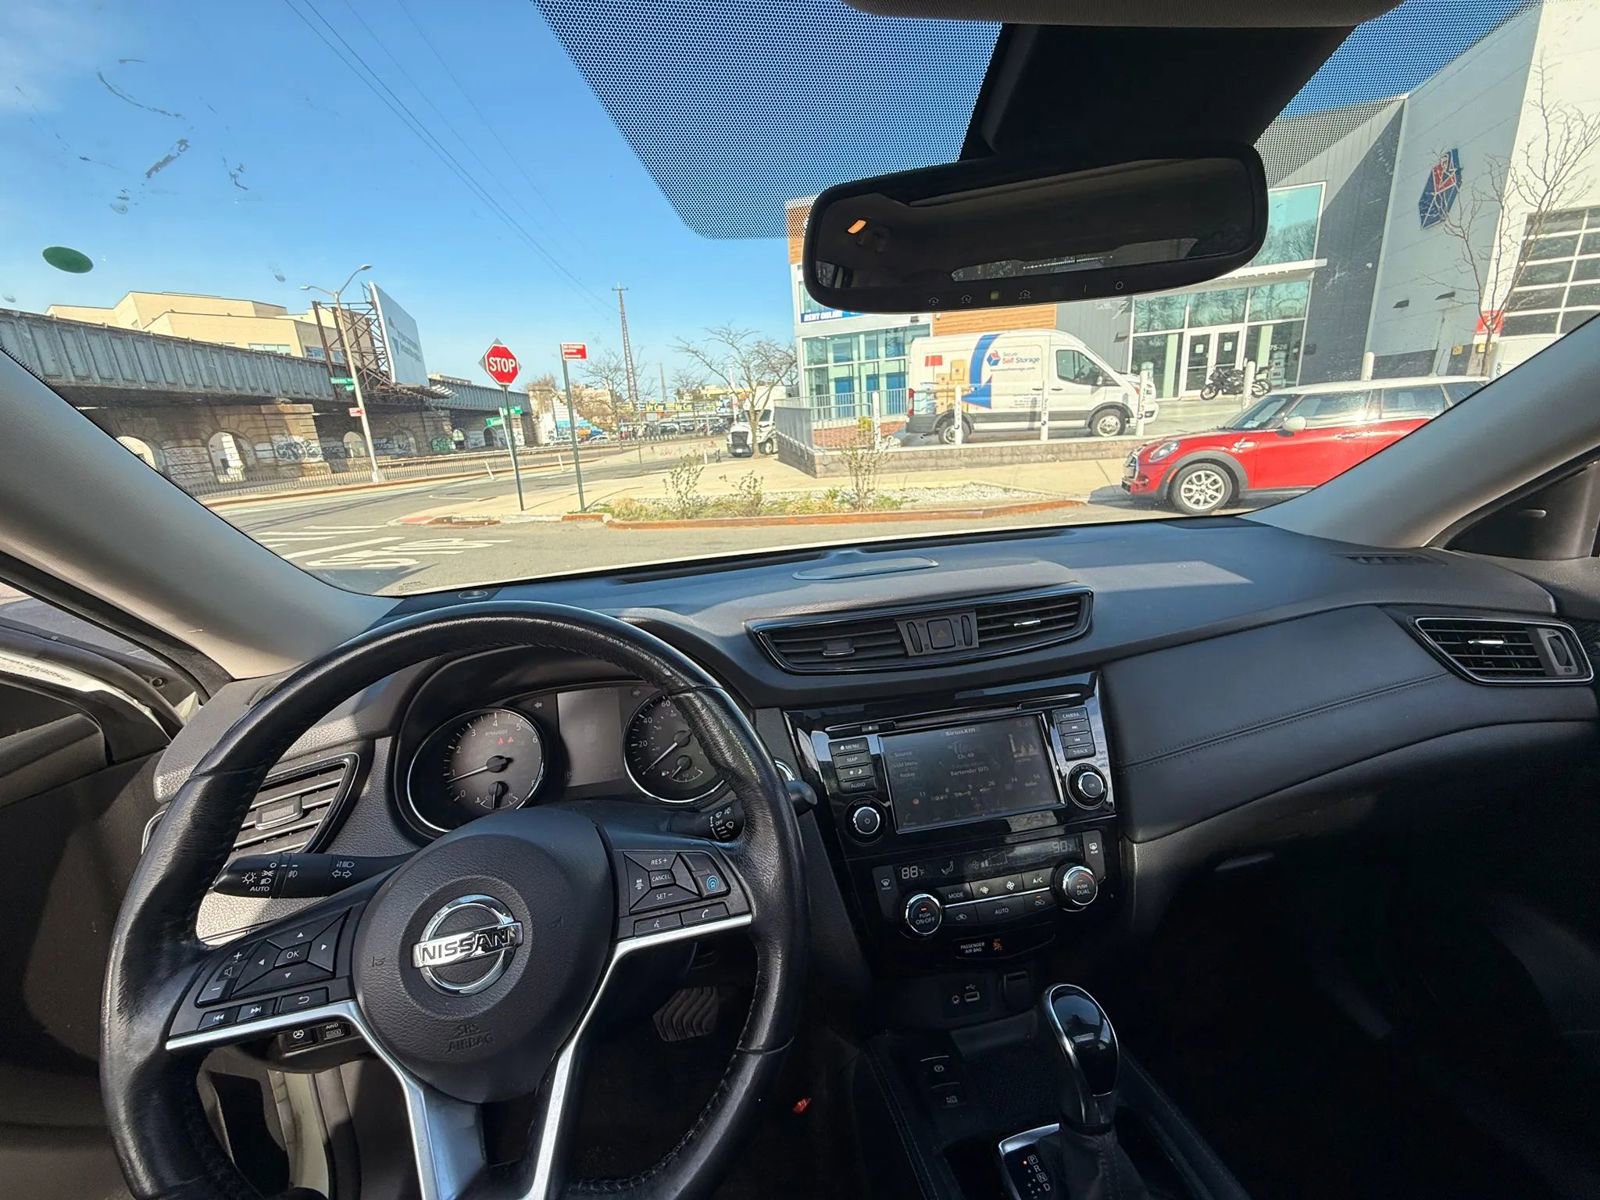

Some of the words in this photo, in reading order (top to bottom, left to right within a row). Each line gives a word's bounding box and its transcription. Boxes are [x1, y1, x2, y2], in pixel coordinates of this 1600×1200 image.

[488, 356, 516, 374] STOP
[1015, 356, 1041, 365] Storage
[492, 719, 498, 727] 4
[643, 716, 653, 724] 40
[515, 722, 522, 731] 5
[471, 728, 477, 737] 3
[532, 735, 538, 743] 6
[639, 740, 648, 748] 20
[456, 745, 462, 754] 2
[460, 789, 466, 798] 0
[1052, 840, 1068, 854] 90
[901, 865, 919, 880] 88
[651, 873, 671, 882] CANCEL
[1033, 876, 1044, 885] A/C
[249, 885, 270, 893] AUTO
[1076, 889, 1091, 897] DUAL
[948, 892, 965, 900] MODE
[994, 907, 1010, 915] AUTO
[421, 926, 512, 962] NISSAN
[960, 941, 985, 950] PASSENGER
[286, 949, 300, 960] OK
[1033, 1164, 1041, 1172] R
[1043, 1182, 1051, 1191] D
